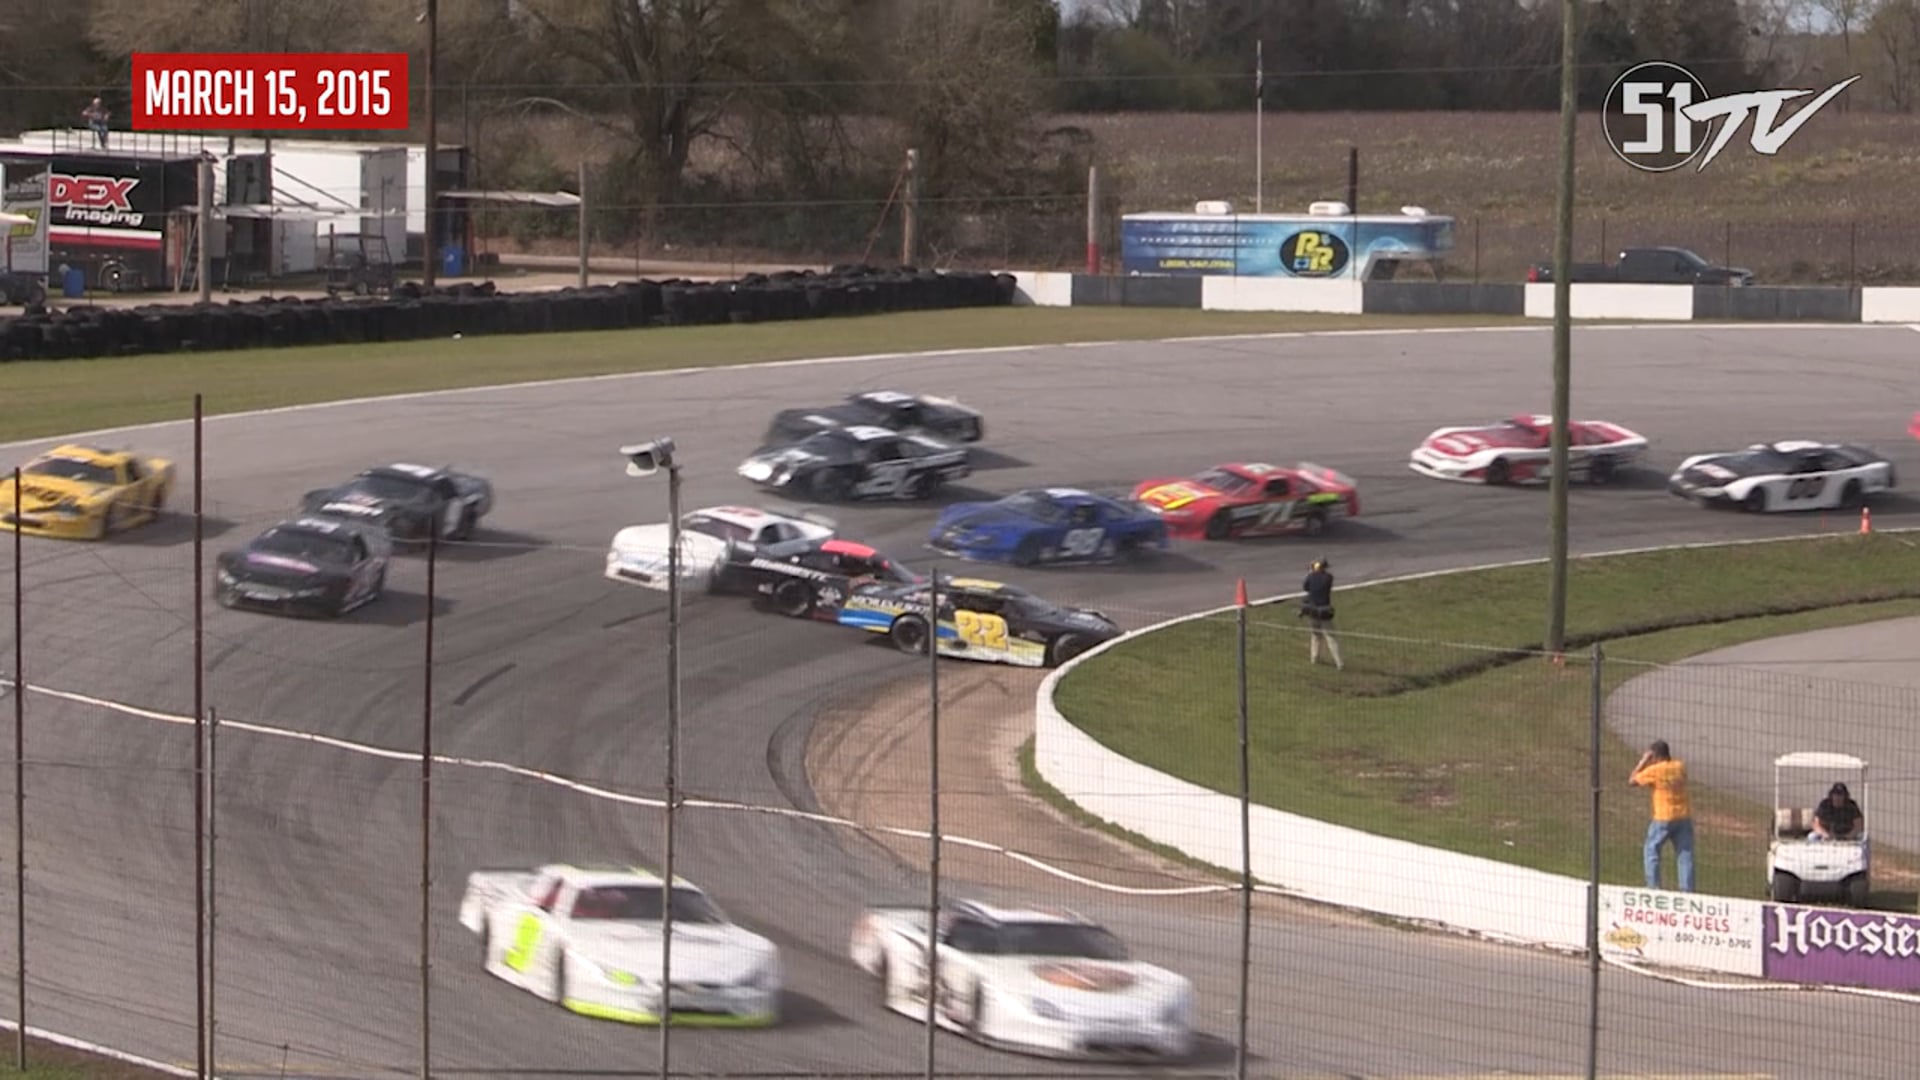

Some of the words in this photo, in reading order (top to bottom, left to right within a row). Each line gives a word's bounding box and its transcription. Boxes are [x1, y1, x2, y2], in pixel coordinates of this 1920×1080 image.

[49, 174, 140, 210] DEX
[954, 609, 1009, 651] 22
[1622, 891, 1704, 915] GREEN
[1623, 907, 1679, 928] RACING
[1683, 914, 1731, 933] FUELS
[1770, 906, 1920, 957] Hoosie
